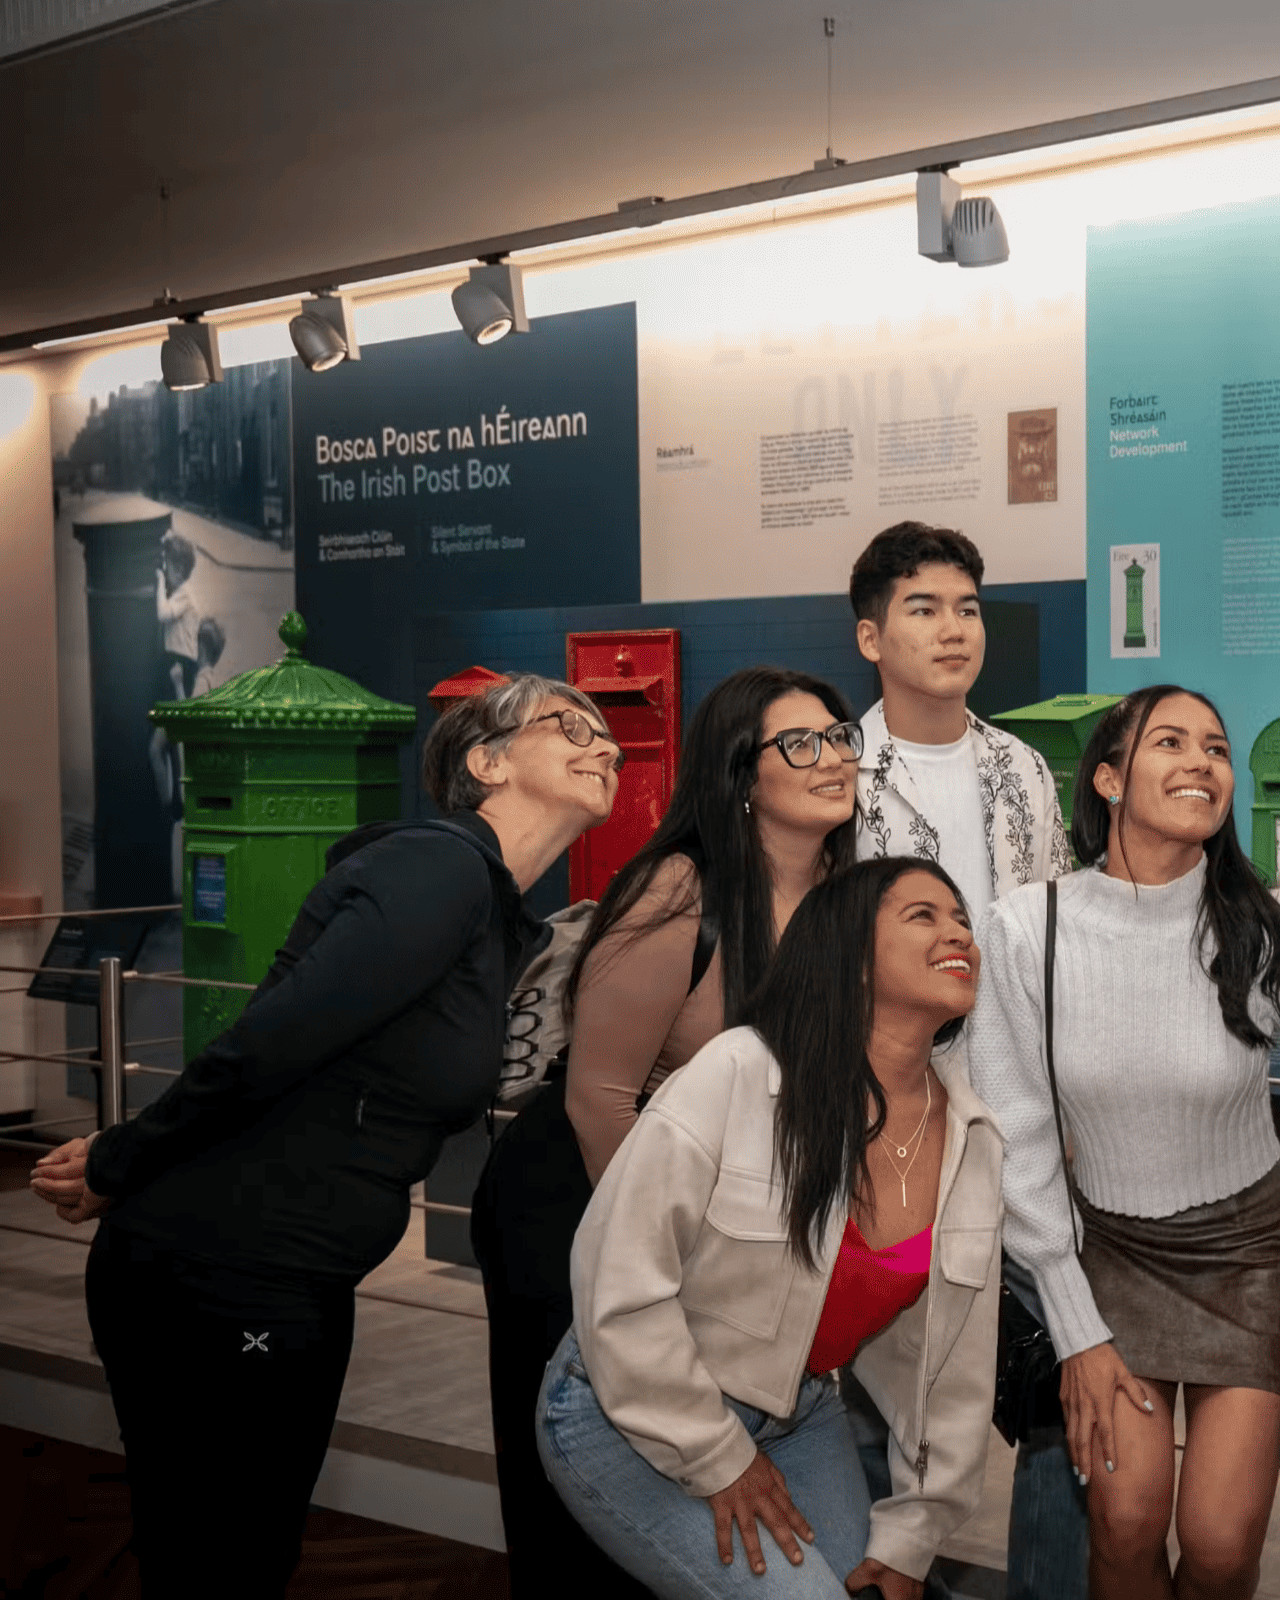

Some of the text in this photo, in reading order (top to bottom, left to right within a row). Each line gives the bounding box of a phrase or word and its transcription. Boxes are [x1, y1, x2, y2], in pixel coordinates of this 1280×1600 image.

[1110, 394, 1160, 409] Forbairt
[316, 405, 587, 464] Bosca Poist na hÉireann
[1110, 426, 1159, 442] Network
[1110, 440, 1187, 458] Development
[318, 459, 511, 503] The Irish Post Box
[439, 539, 473, 556] Symbol
[501, 535, 526, 549] State
[262, 796, 340, 820] OFFICE
